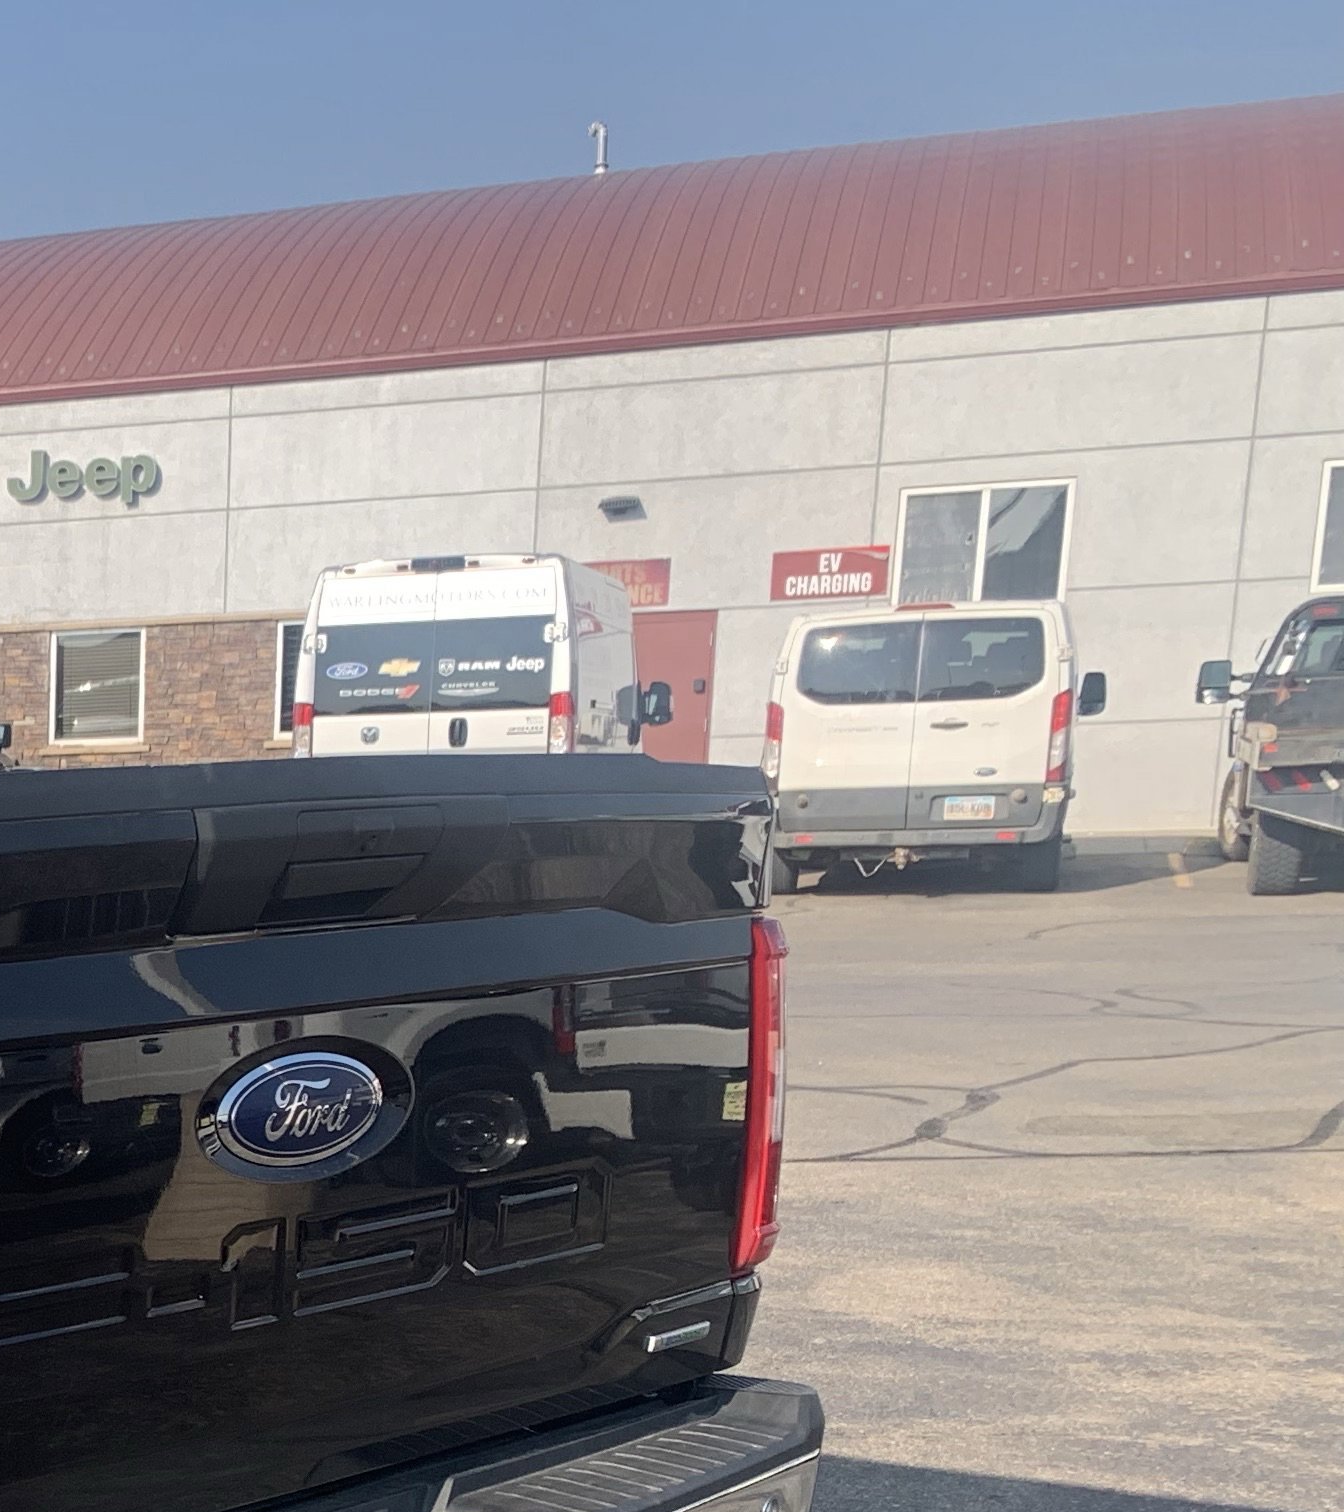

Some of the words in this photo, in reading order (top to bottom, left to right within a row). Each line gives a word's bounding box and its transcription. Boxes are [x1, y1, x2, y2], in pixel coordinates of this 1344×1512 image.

[6, 449, 160, 505] Jeep
[819, 552, 843, 573] EV
[785, 573, 873, 597] CHARGING
[458, 661, 501, 672] RAM
[506, 655, 545, 673] Jeep
[265, 1076, 353, 1143] Ford
